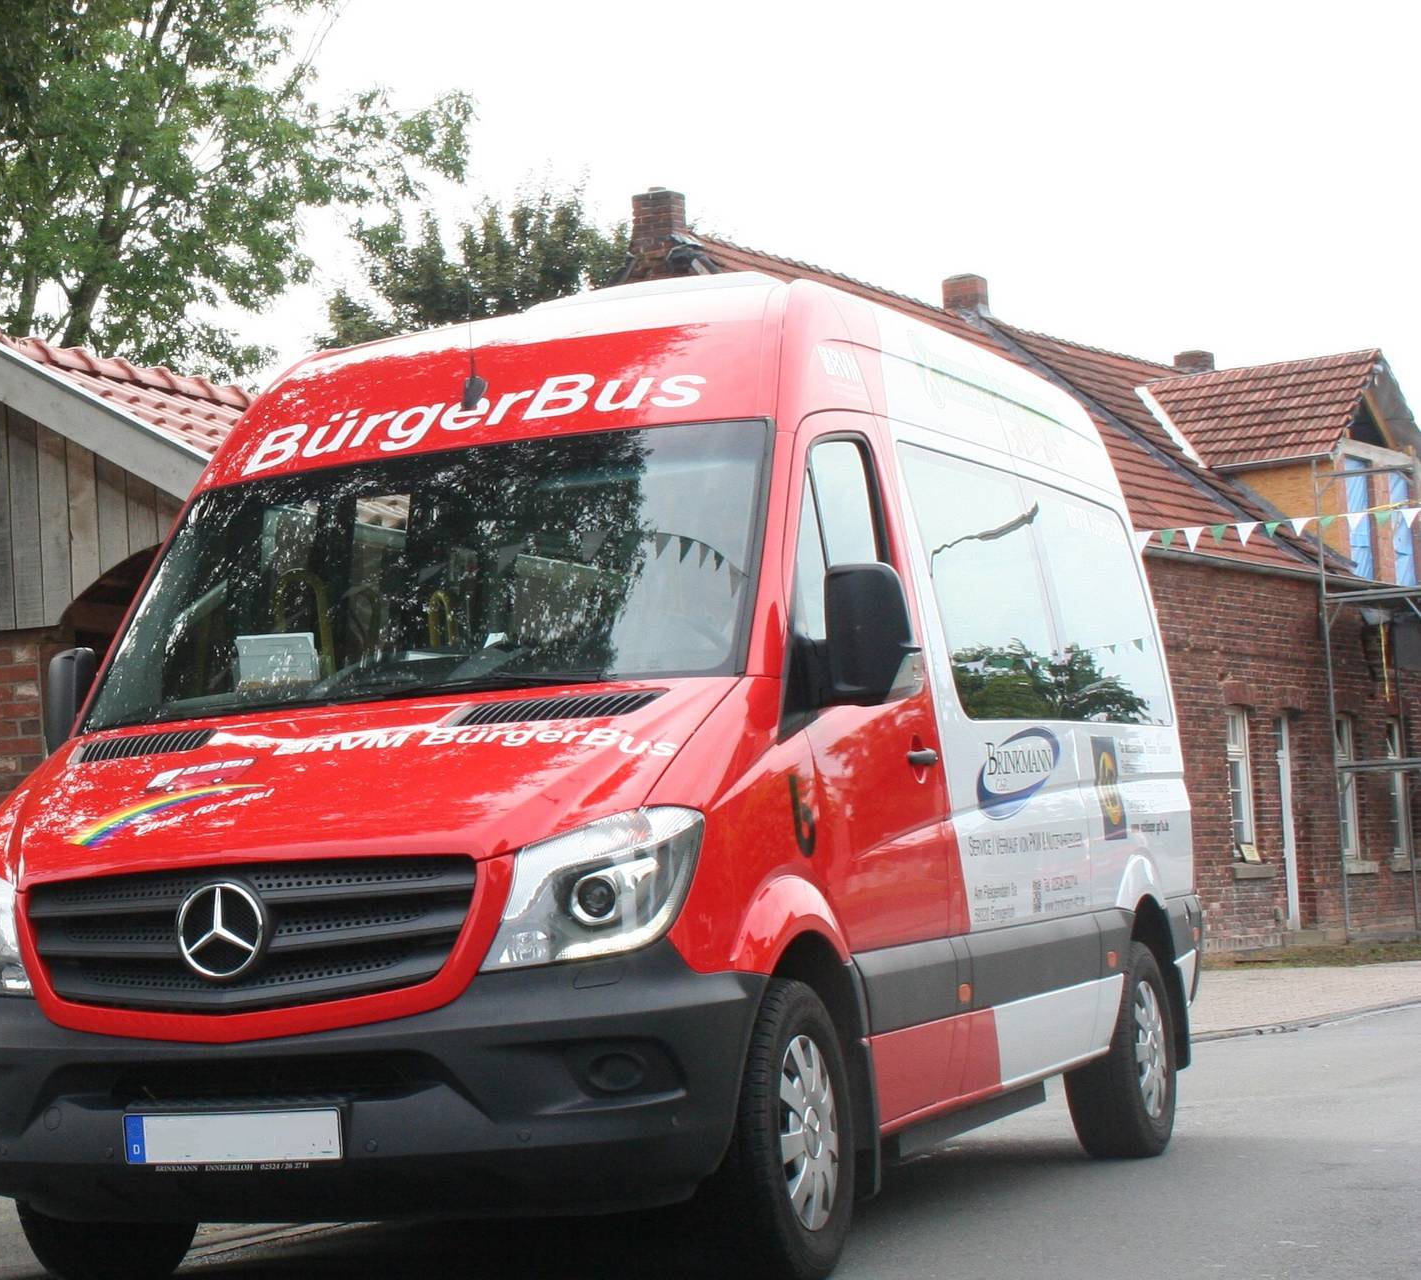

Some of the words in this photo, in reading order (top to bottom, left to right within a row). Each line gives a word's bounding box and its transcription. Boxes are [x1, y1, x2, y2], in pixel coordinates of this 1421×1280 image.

[241, 374, 707, 477] BürgerBus
[418, 727, 678, 757] BürgerBus
[133, 1144, 141, 1154] D
[155, 1164, 198, 1172] BRINKMANN
[205, 1163, 253, 1172] ENNIGERLOH
